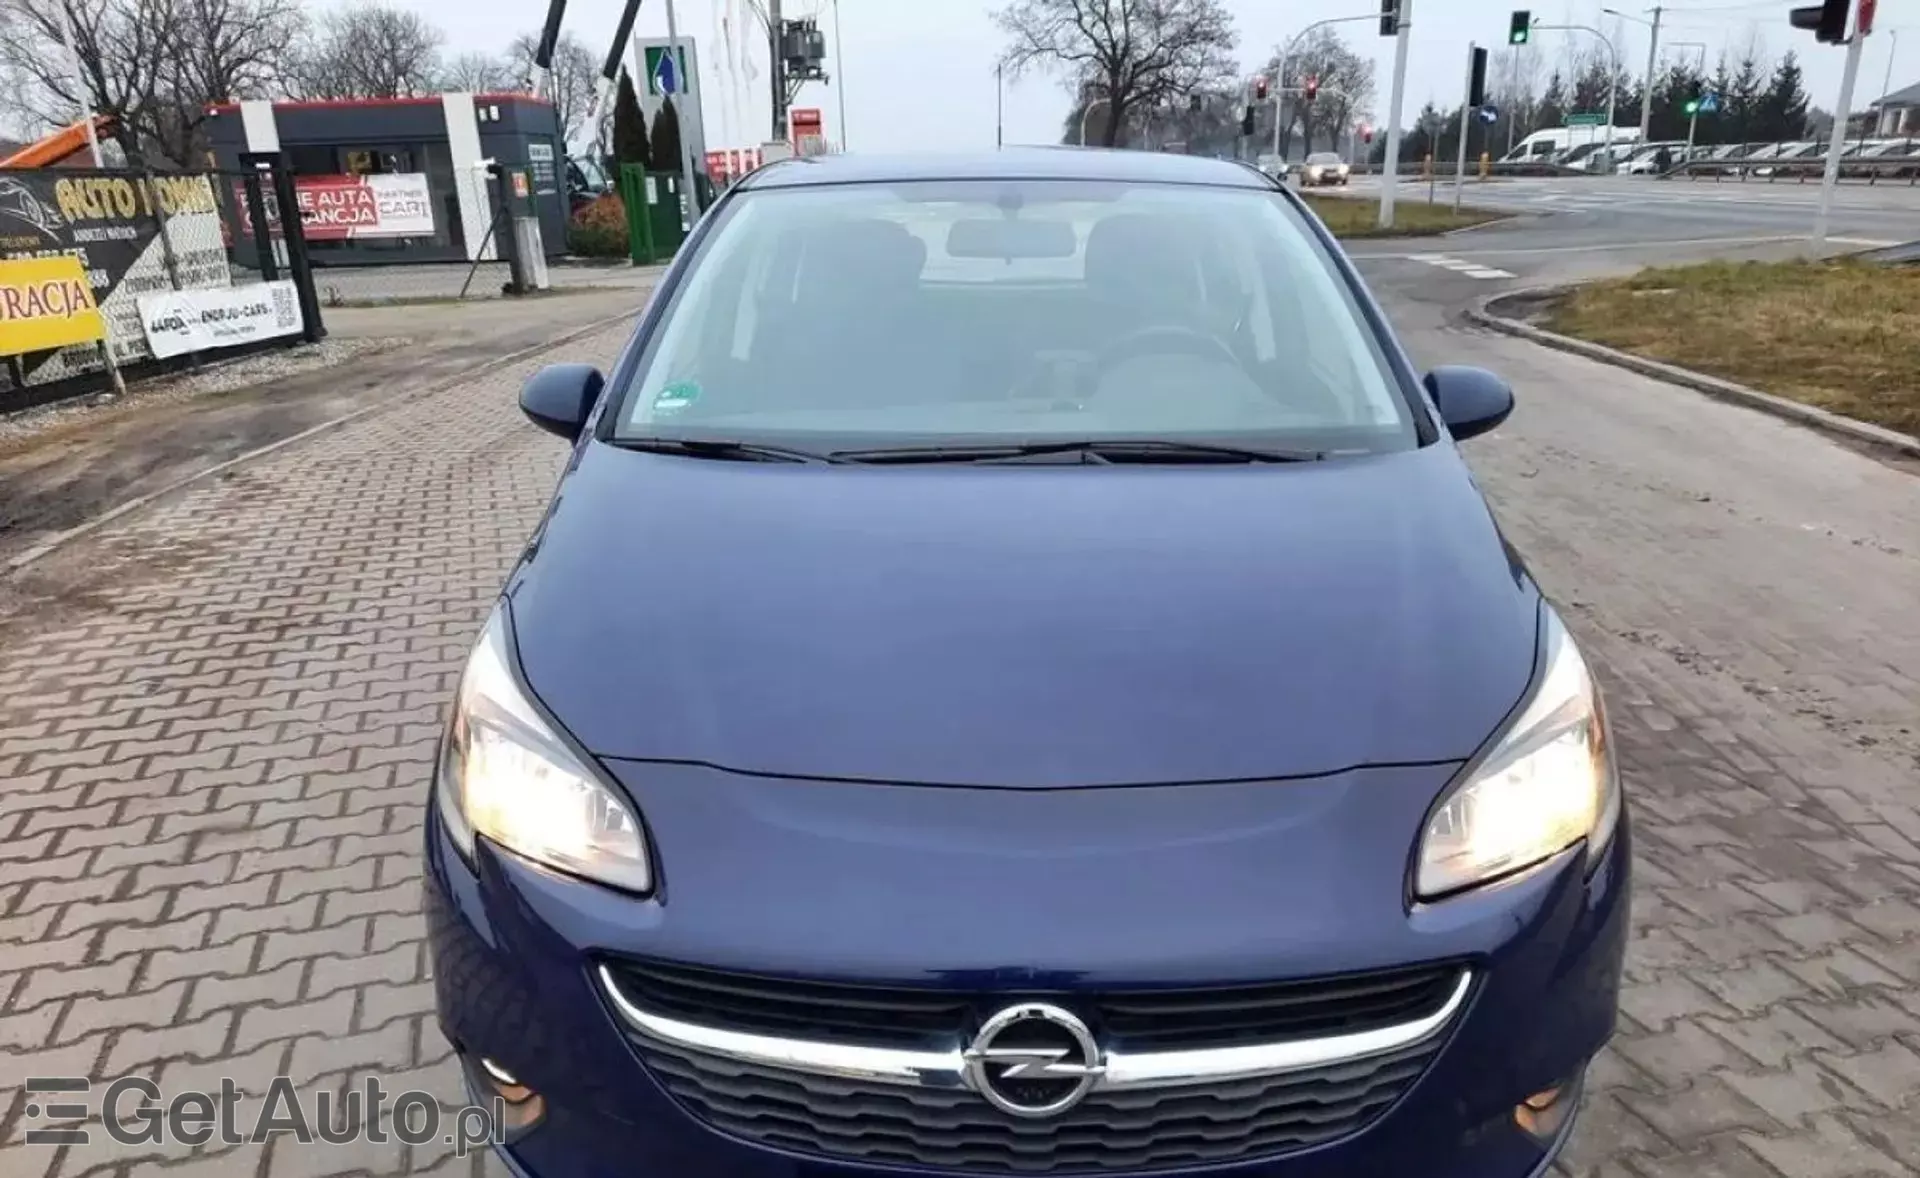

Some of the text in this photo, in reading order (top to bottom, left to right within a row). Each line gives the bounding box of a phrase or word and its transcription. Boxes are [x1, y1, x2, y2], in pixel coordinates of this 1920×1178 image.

[56, 177, 136, 223] AUTO
[318, 189, 373, 206] AUTA
[0, 279, 91, 319] RACJA
